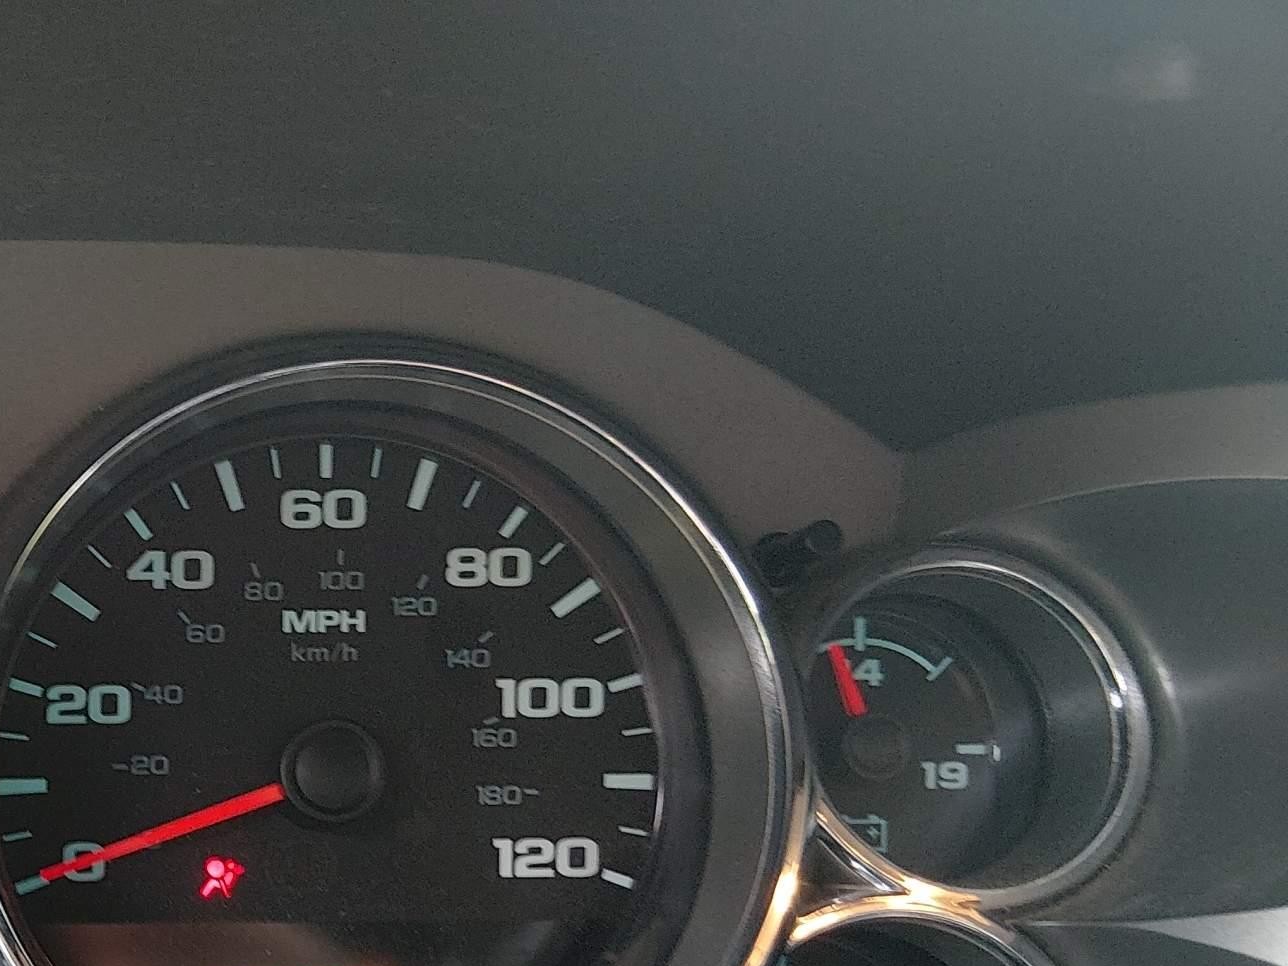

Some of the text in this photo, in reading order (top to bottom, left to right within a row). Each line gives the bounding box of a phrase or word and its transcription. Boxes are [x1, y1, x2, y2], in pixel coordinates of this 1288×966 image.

[279, 489, 367, 529] 60
[125, 550, 216, 590] 40
[444, 547, 533, 587] 80
[244, 581, 284, 601] 80
[317, 571, 365, 591] 100
[392, 596, 438, 616] 120
[281, 609, 367, 633] MPH
[185, 623, 226, 643] 60
[290, 642, 360, 663] km/h
[444, 648, 491, 668] 140
[841, 657, 886, 687] 4
[46, 684, 132, 724] 20
[143, 684, 184, 704] 40
[495, 677, 605, 718] 100
[472, 728, 517, 748] 160
[130, 755, 170, 775] 20
[920, 760, 969, 790] 19
[475, 785, 523, 805] 180
[62, 841, 105, 882] 0
[492, 836, 600, 878] 120
